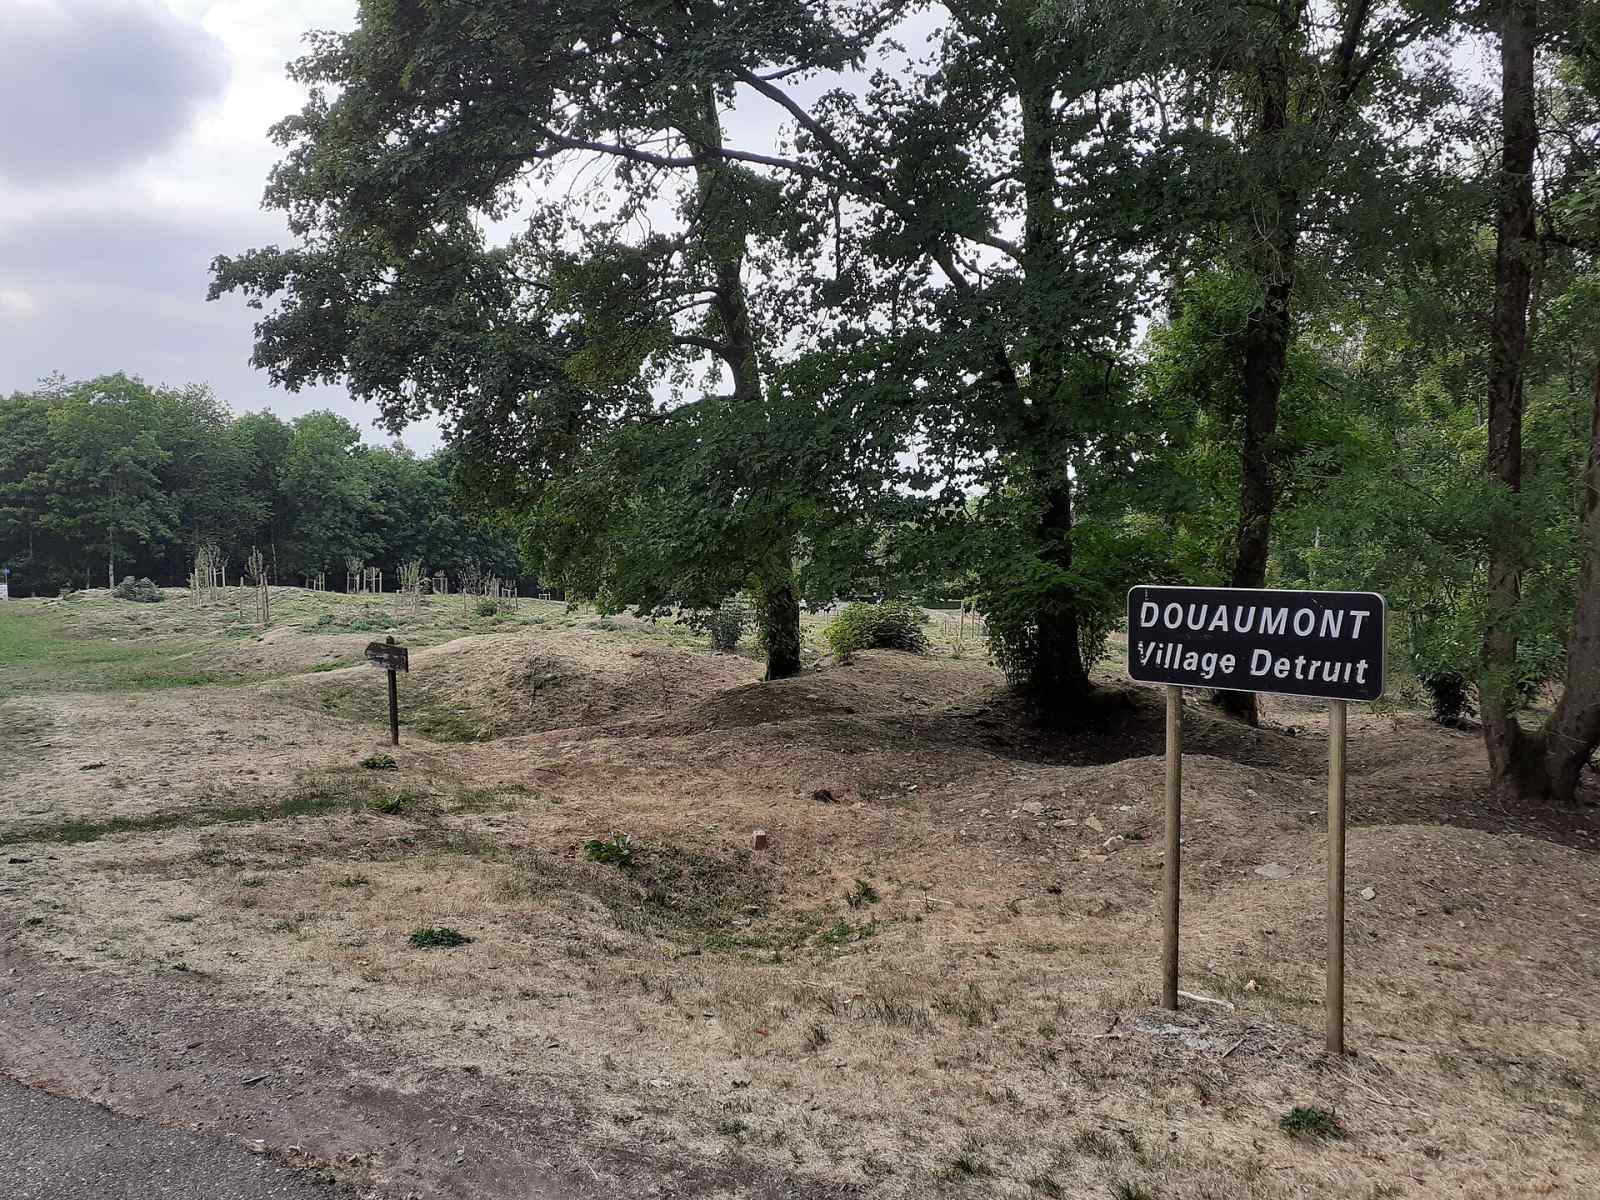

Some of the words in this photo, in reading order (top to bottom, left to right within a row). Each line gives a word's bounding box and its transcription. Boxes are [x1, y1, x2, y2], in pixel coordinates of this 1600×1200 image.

[1140, 602, 1370, 639] DOUAUMONT
[1137, 641, 1236, 679] Village
[1250, 649, 1369, 684] Detruit
